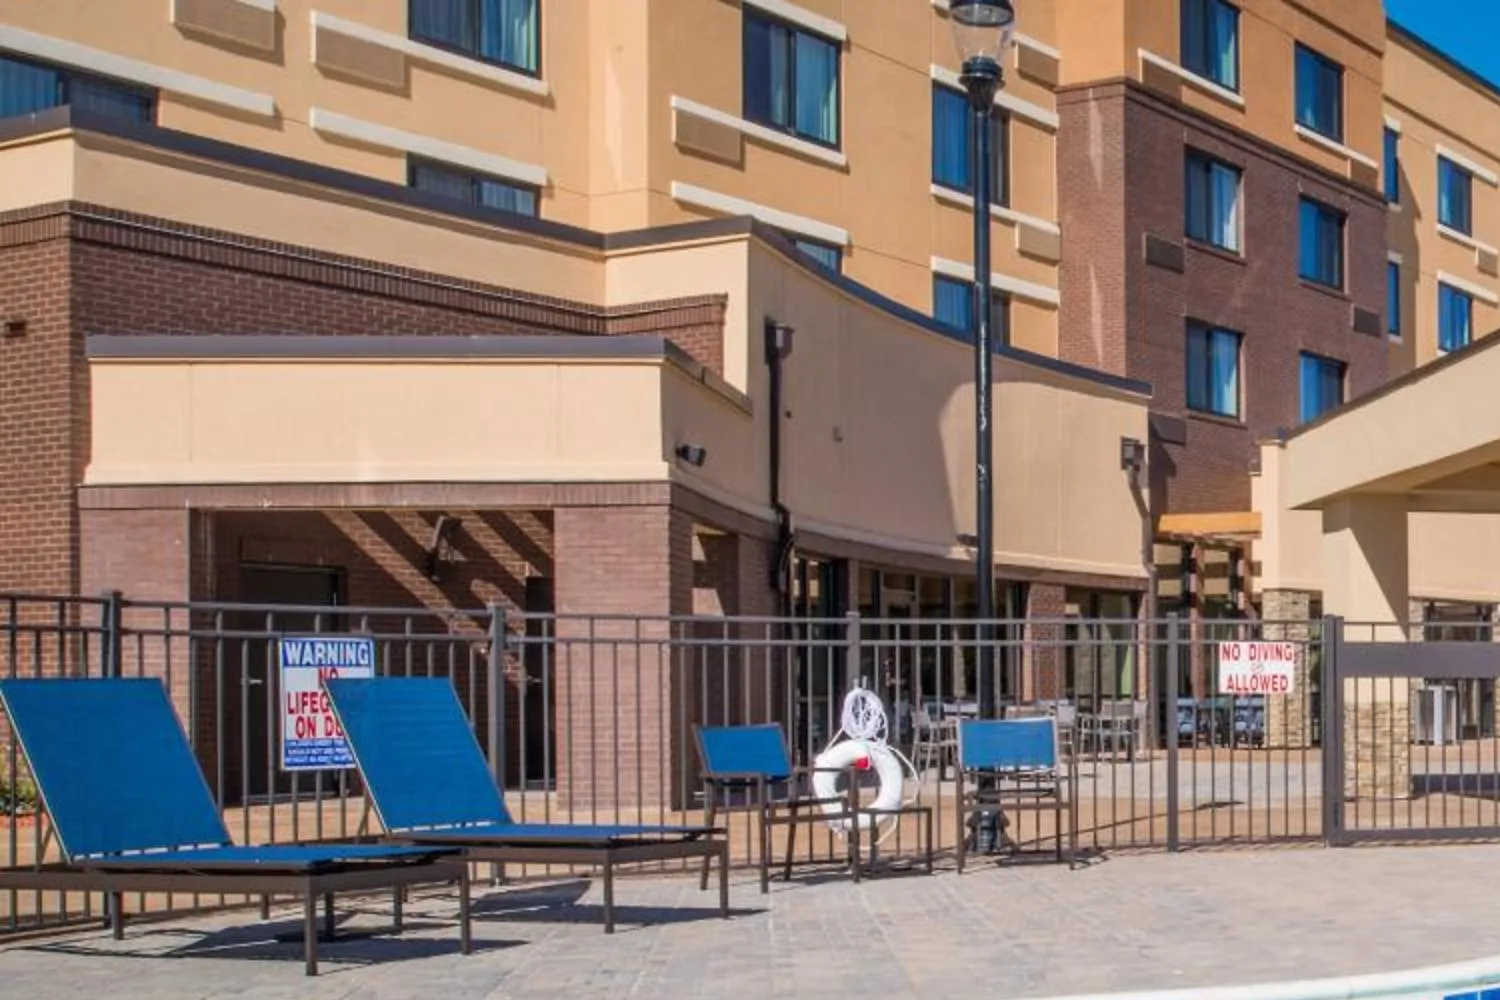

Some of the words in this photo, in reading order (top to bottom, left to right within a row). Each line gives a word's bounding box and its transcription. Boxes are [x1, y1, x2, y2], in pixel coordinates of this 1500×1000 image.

[285, 641, 369, 665] WARNING
[1222, 643, 1240, 661] NO
[1249, 643, 1293, 661] DIVING
[1226, 673, 1289, 691] ALLOWED
[287, 691, 331, 714] LIFEG
[295, 716, 317, 738] ON
